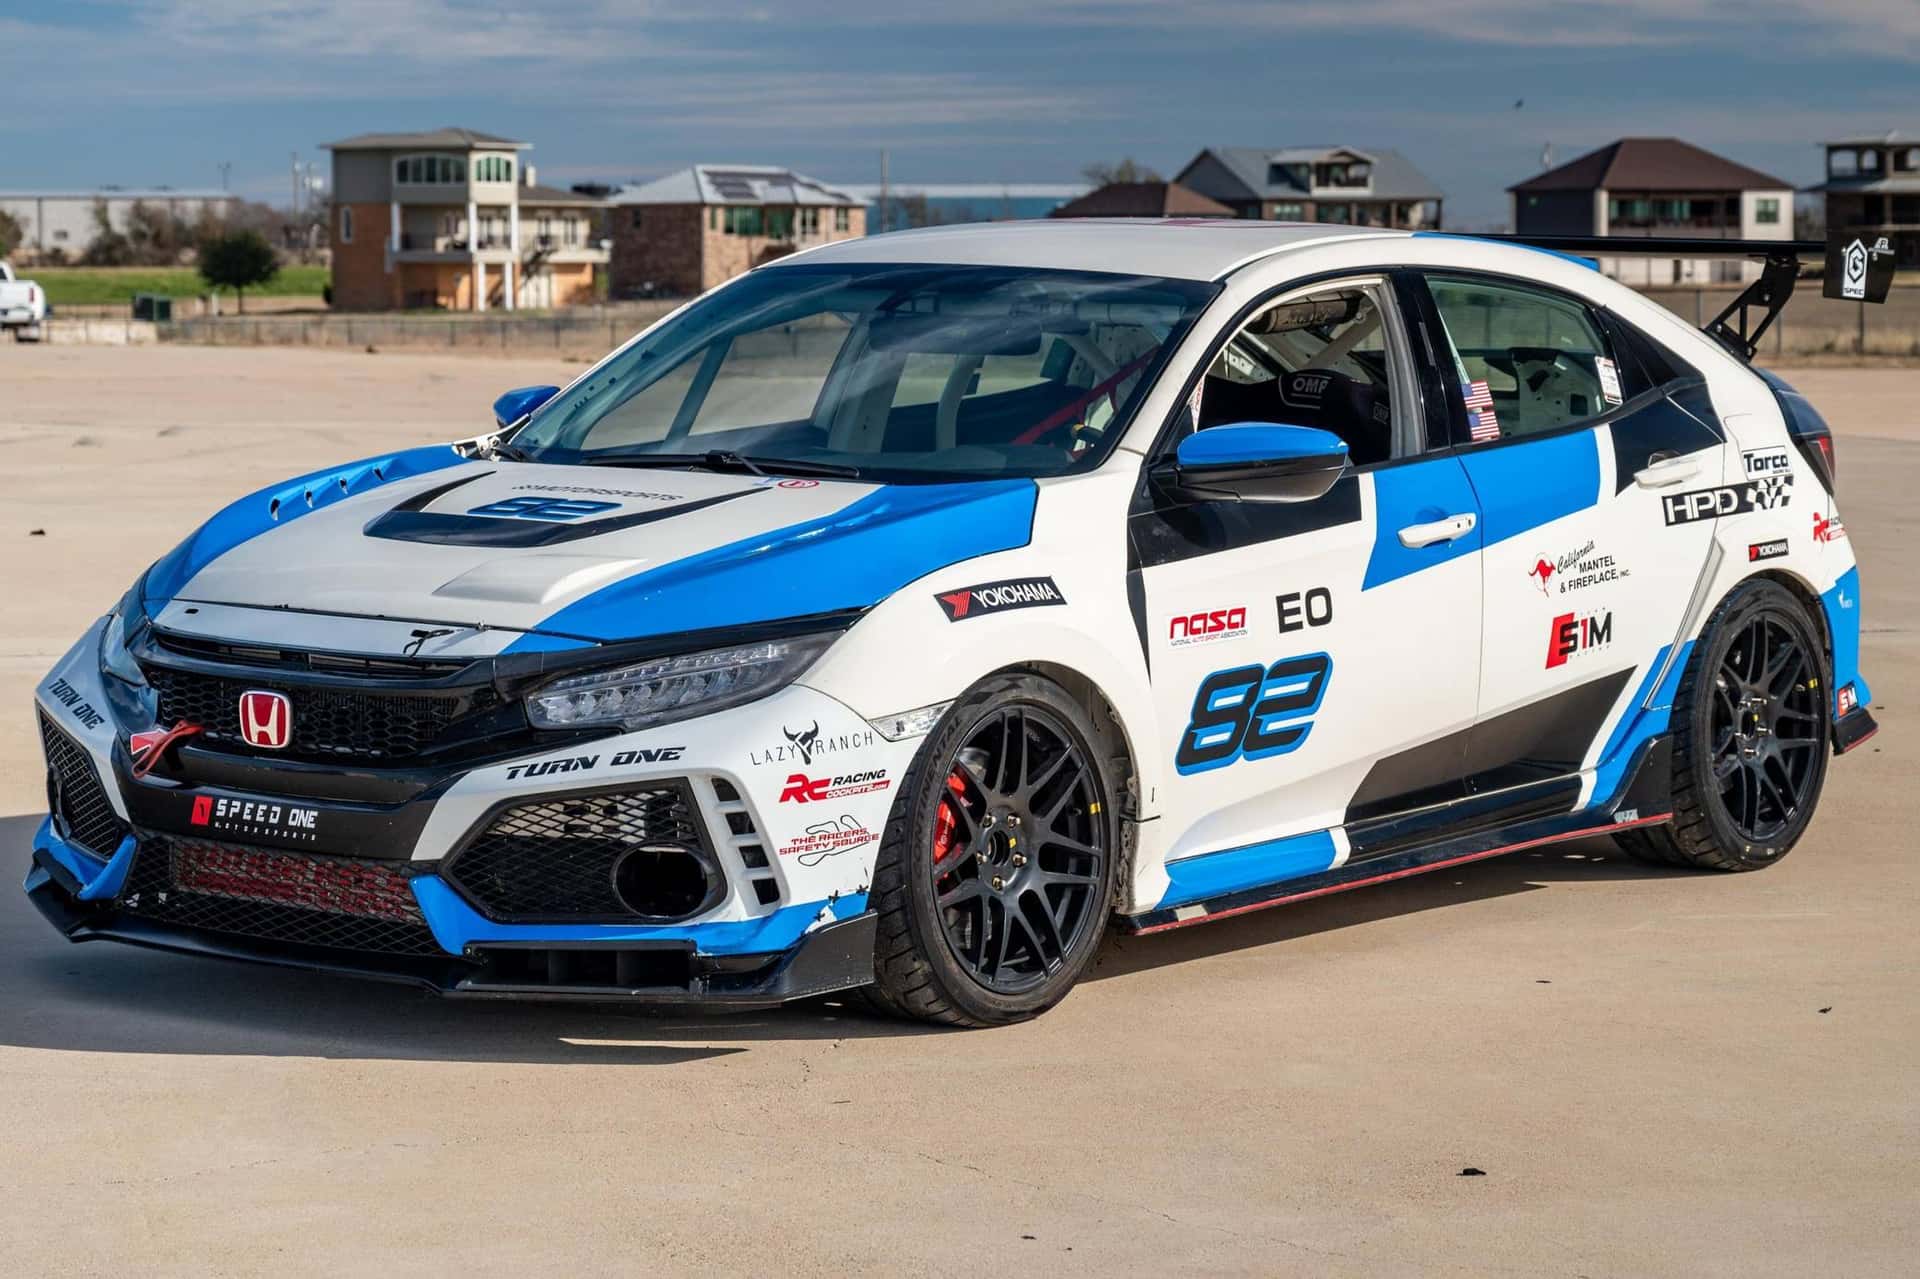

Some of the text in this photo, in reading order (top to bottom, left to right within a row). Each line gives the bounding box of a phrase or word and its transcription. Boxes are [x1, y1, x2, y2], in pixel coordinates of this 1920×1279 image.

[1292, 377, 1329, 394] OMP
[1666, 487, 1740, 524] HPD
[1557, 540, 1596, 574] California
[1579, 555, 1616, 573] MANTEL
[971, 582, 1060, 608] YOKOHAMA
[1559, 582, 1566, 594] &
[1568, 568, 1619, 592] FIREPLACE,
[48, 677, 106, 730] TURN ONE
[1175, 651, 1334, 776] 82
[506, 746, 687, 780] TURN ONE
[750, 731, 873, 766] LAZY RANCH
[779, 773, 832, 803] RC
[832, 769, 887, 787] RACING
[215, 798, 319, 829] SPEED ONE
[778, 833, 880, 856] SAFETY SOURCE
[790, 827, 868, 846] THE RACERS
